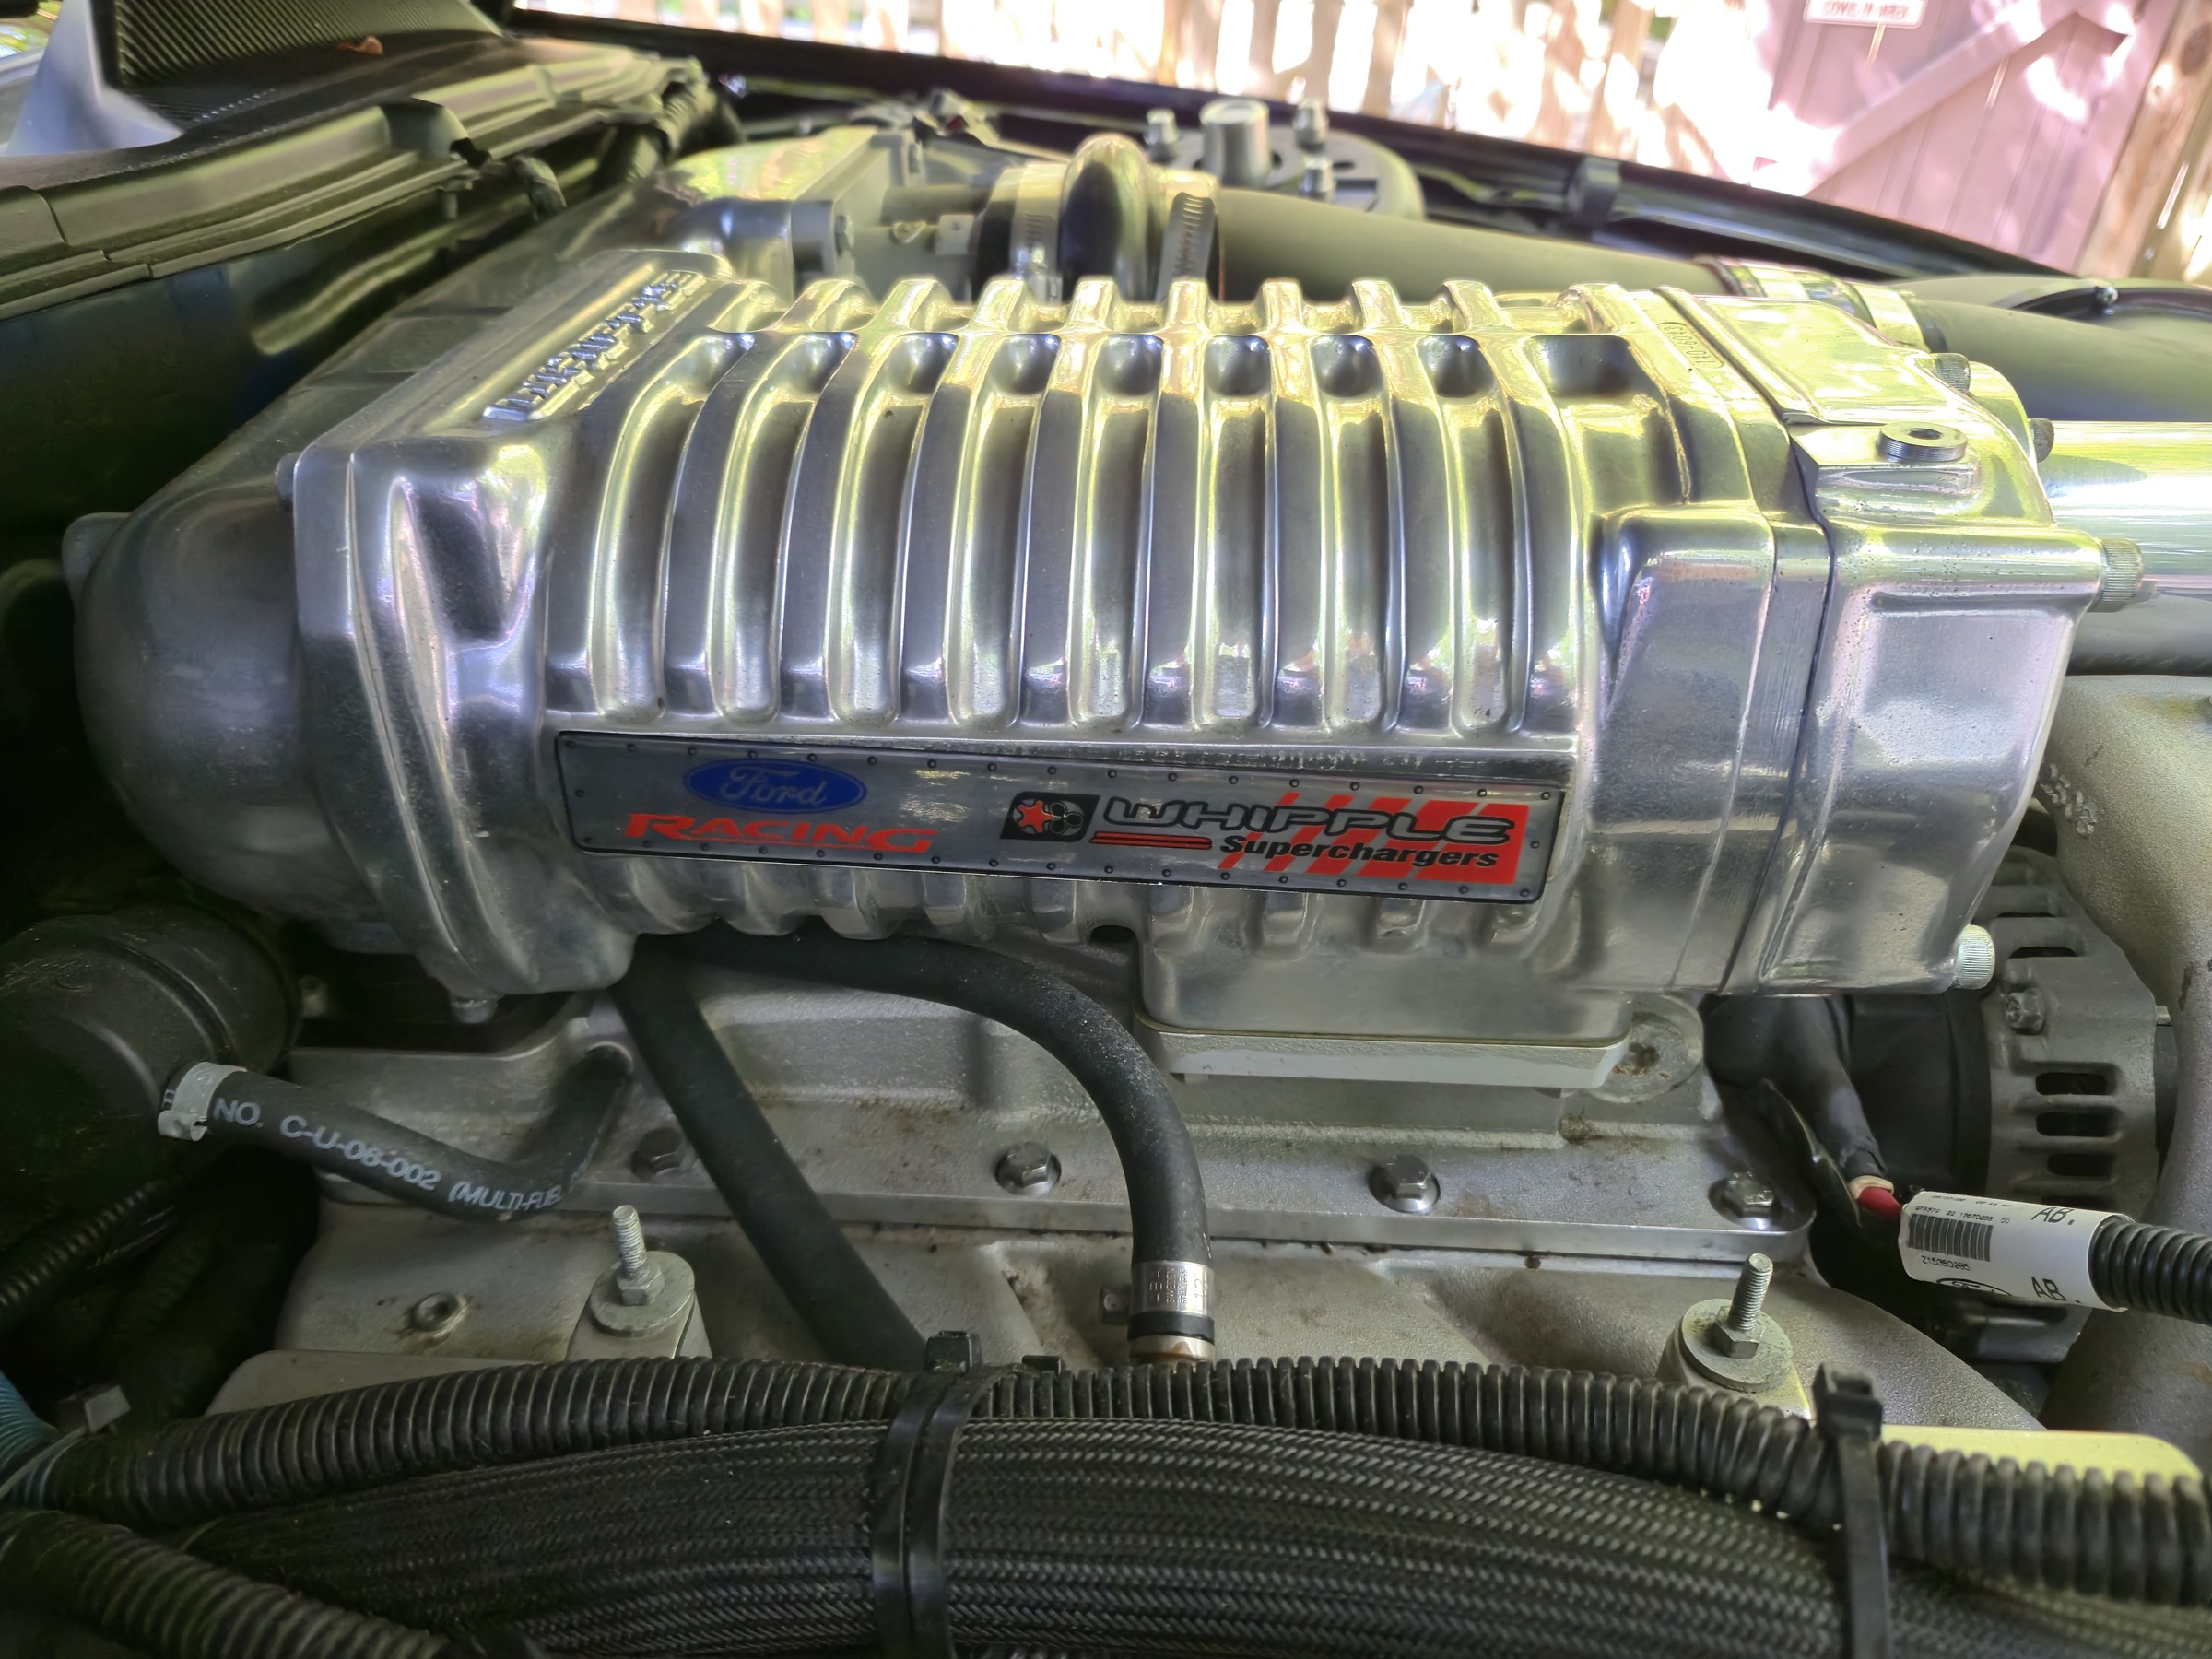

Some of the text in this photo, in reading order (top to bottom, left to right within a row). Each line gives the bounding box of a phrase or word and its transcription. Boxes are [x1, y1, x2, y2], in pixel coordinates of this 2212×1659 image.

[720, 763, 830, 806] Ford
[624, 813, 938, 853] RACING
[1103, 796, 1515, 844] WHIPPLE
[1220, 835, 1500, 867] Superchargers
[214, 1097, 264, 1128] NO.
[2030, 1206, 2075, 1226] AB.
[1179, 1268, 1189, 1304] STAINLESS
